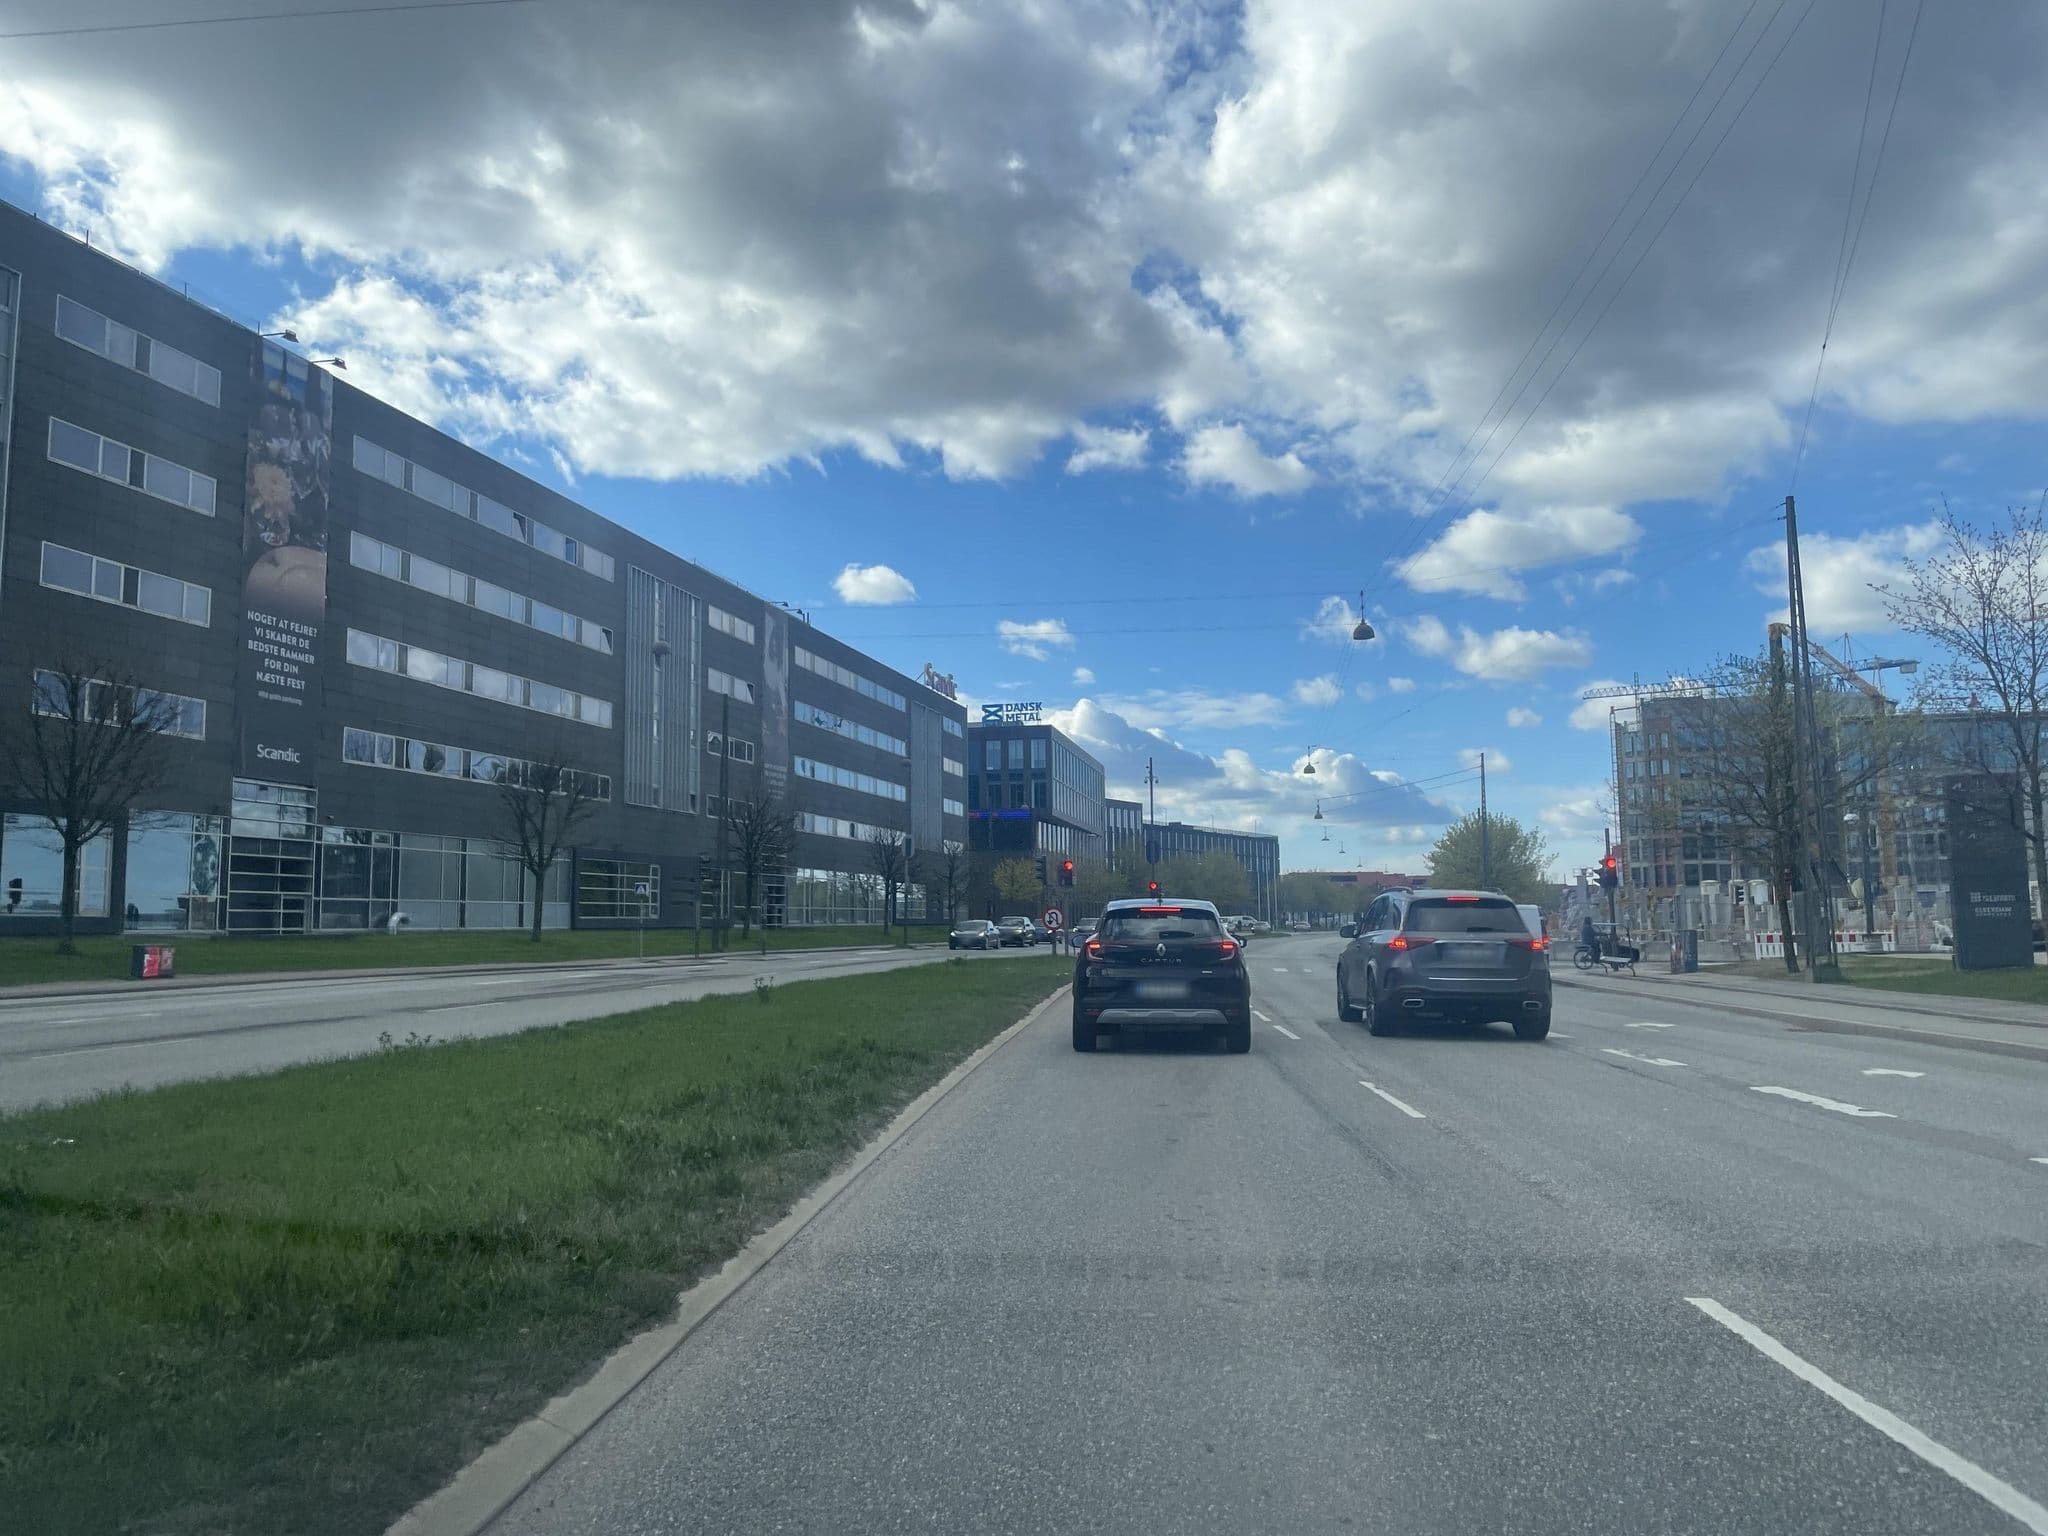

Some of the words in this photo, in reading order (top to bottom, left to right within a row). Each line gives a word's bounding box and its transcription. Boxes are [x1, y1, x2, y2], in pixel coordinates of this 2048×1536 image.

[247, 610, 277, 626] NOGET
[279, 619, 288, 629] AT
[290, 622, 317, 637] FEJRE?
[255, 627, 263, 637] VI
[265, 629, 297, 646] SKABER
[299, 638, 310, 649] DE
[247, 640, 279, 655] BEDSTE
[280, 648, 315, 664] RAMMER
[264, 658, 281, 671] FOR
[283, 662, 299, 674] DIN
[256, 671, 285, 686] NÆSTE
[286, 677, 305, 690] FEST
[1005, 701, 1042, 712] DANSK
[1005, 712, 1041, 722] METAL
[256, 743, 300, 763] Scandic
